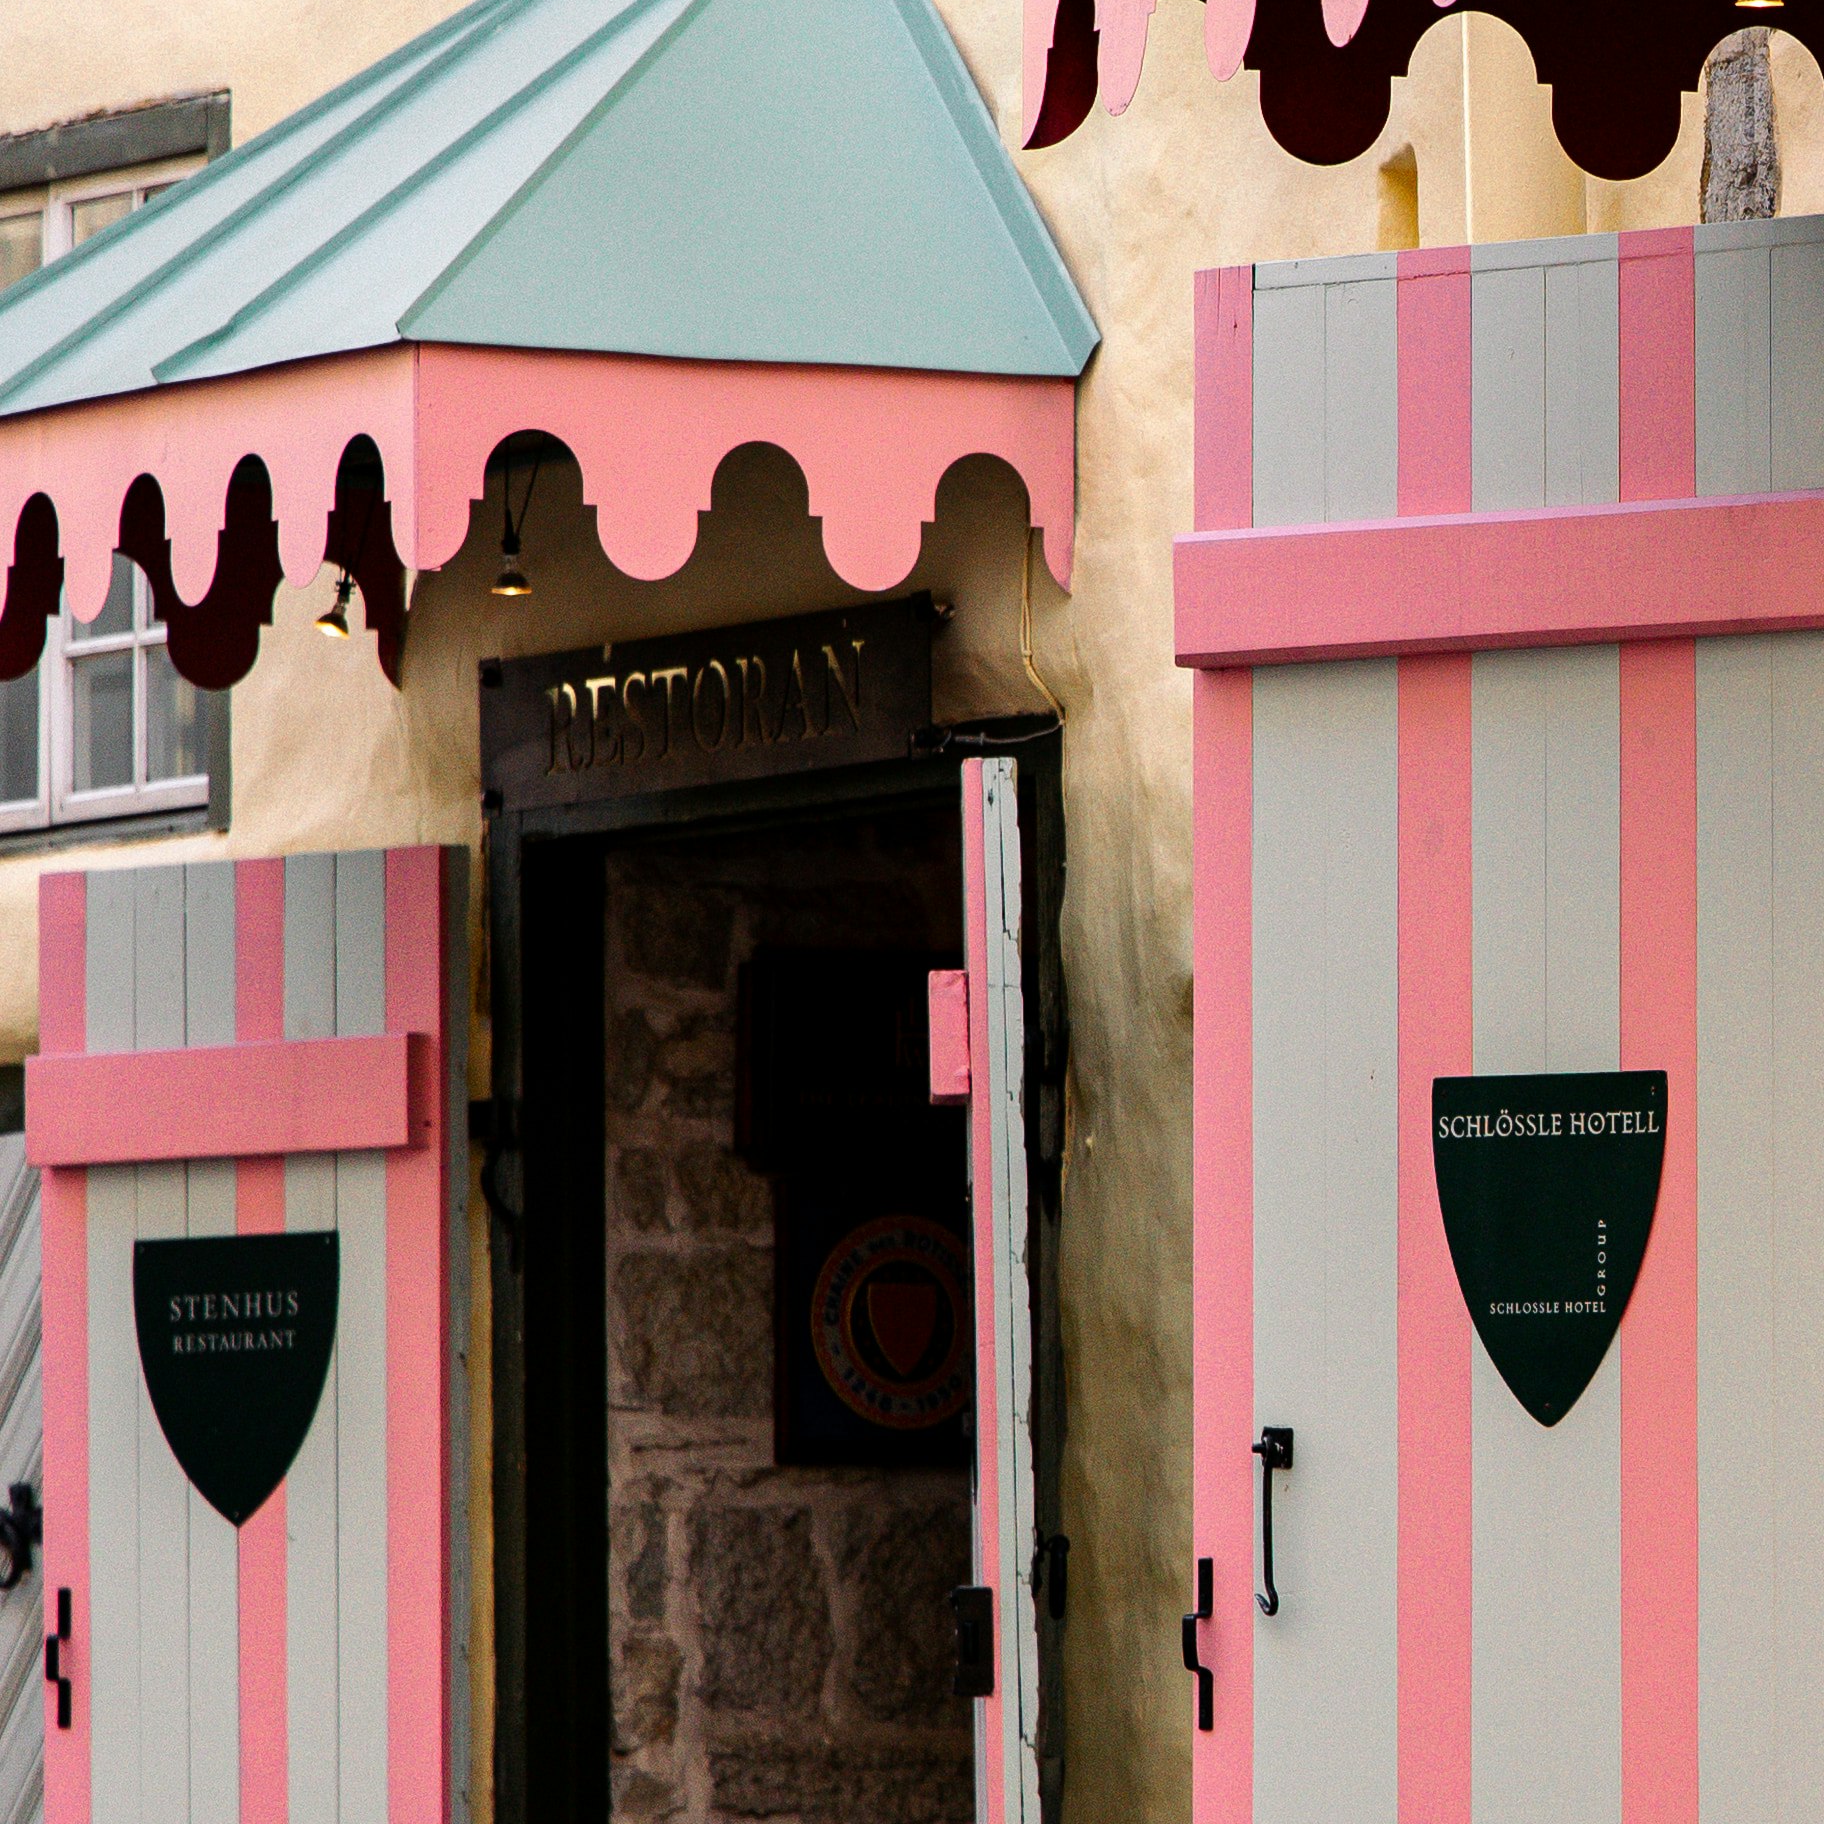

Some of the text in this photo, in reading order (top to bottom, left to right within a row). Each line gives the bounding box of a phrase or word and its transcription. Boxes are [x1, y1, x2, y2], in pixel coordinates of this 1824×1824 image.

[544, 639, 866, 776] RESTORAN
[1438, 1108, 1660, 1139] SCHLÖSSLE HOTELL
[1597, 1219, 1607, 1297] GROUP
[170, 1292, 299, 1321] STENHUS
[1489, 1301, 1606, 1315] SCHLOSSLE HOTEL
[173, 1330, 296, 1353] RESTAURANT
